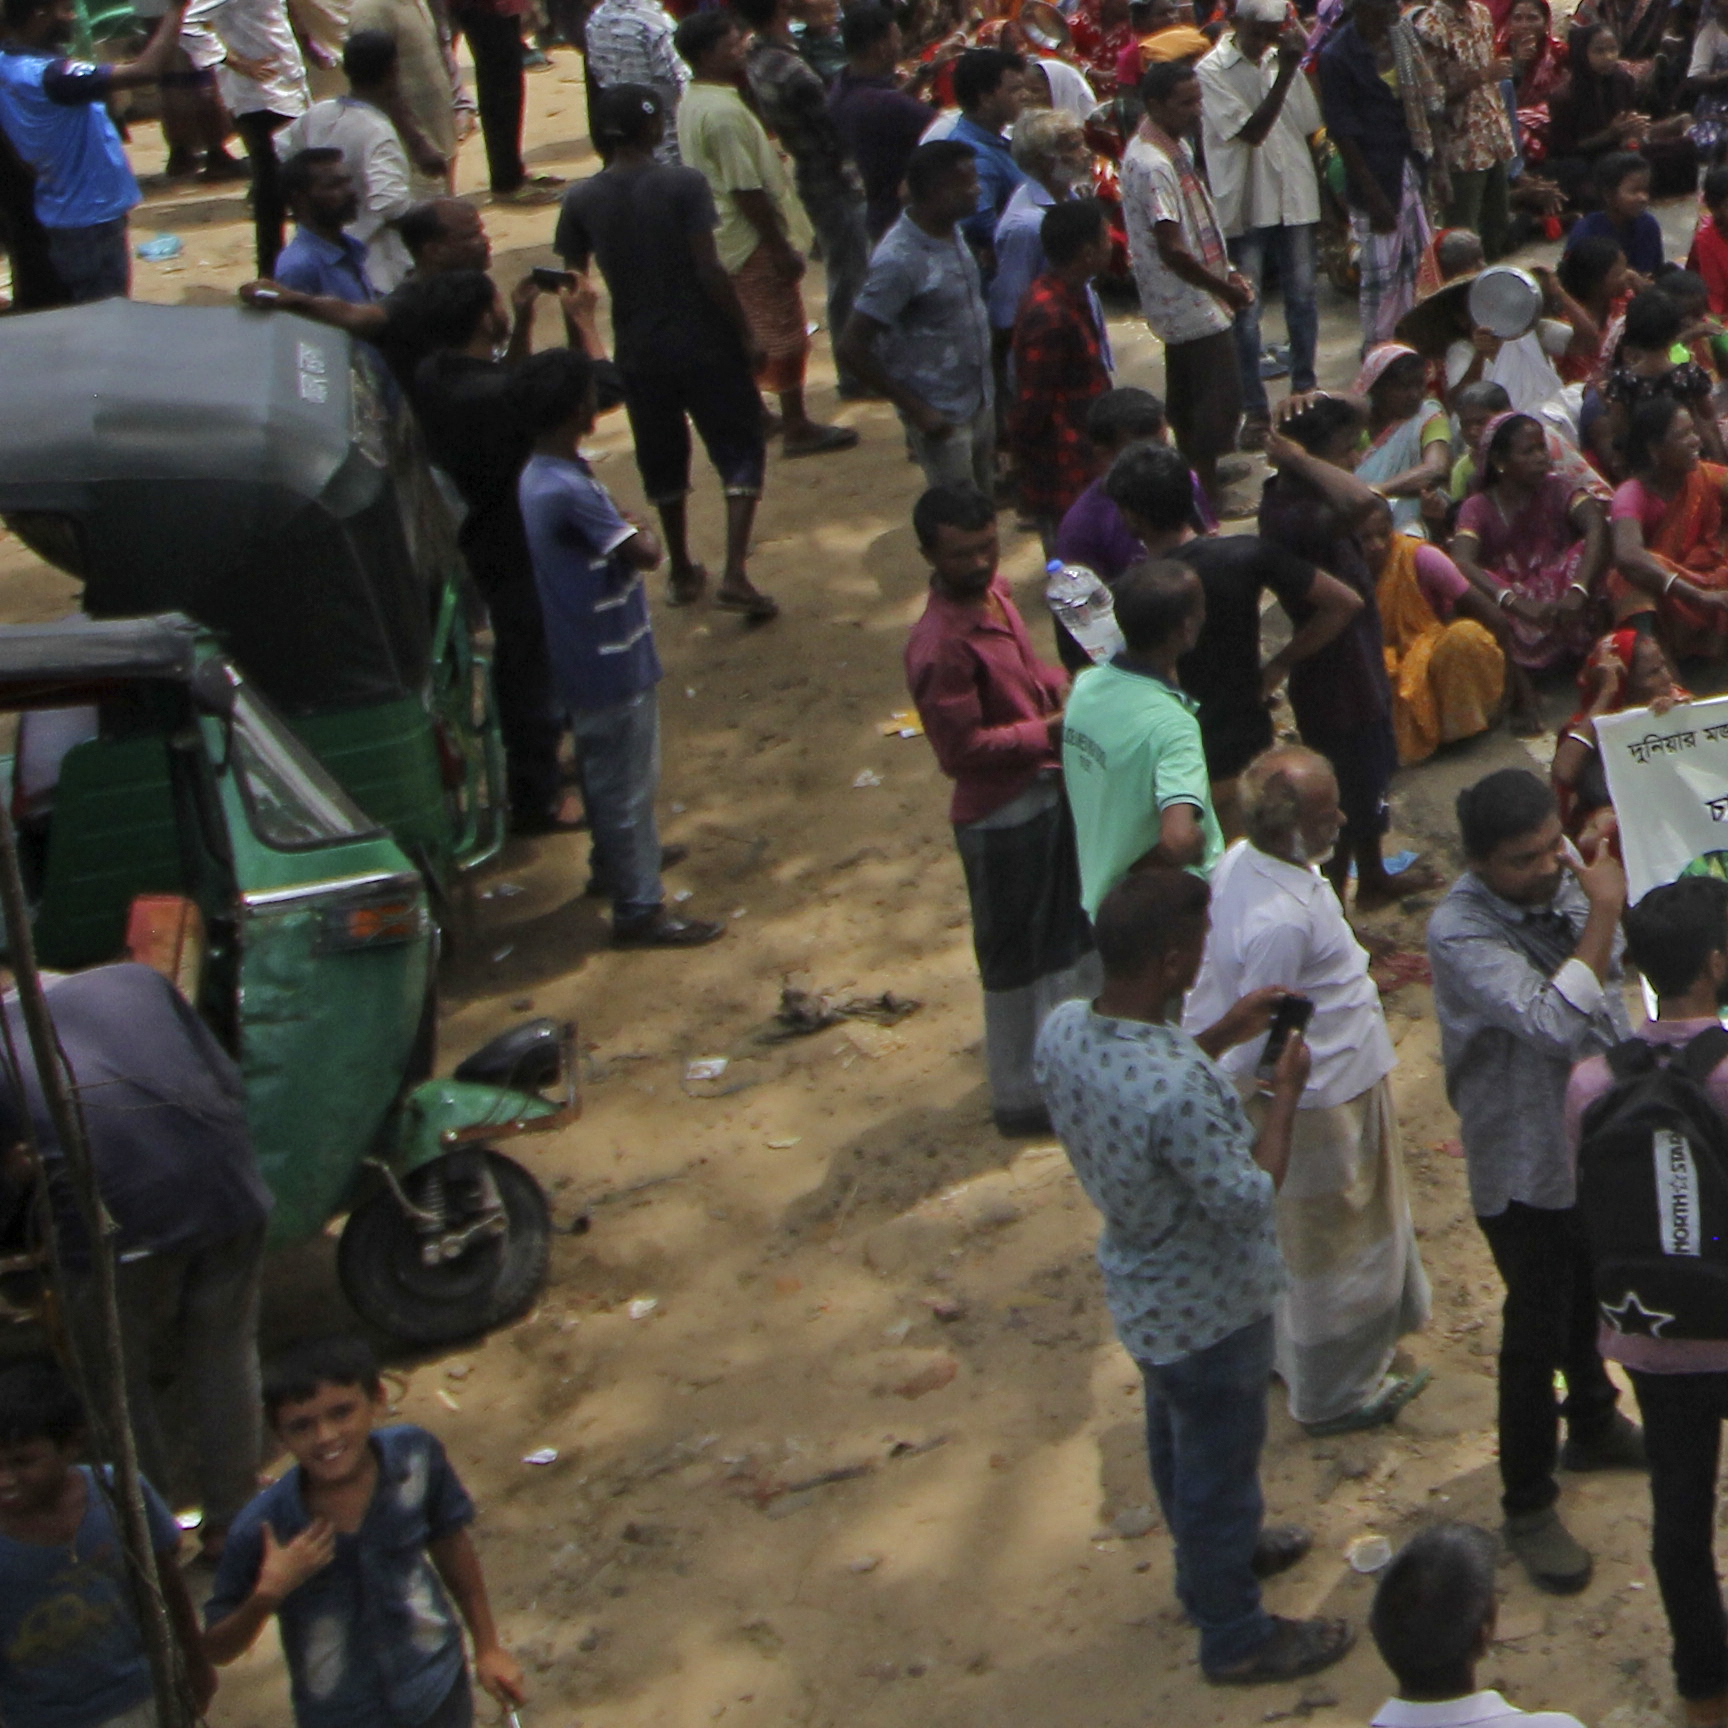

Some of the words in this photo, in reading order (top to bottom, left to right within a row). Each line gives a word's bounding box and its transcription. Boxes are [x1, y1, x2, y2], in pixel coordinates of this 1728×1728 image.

[1627, 731, 1697, 764] দুনিয়ার
[1669, 1132, 1687, 1174] STAR
[1672, 1193, 1691, 1254] NORTH
